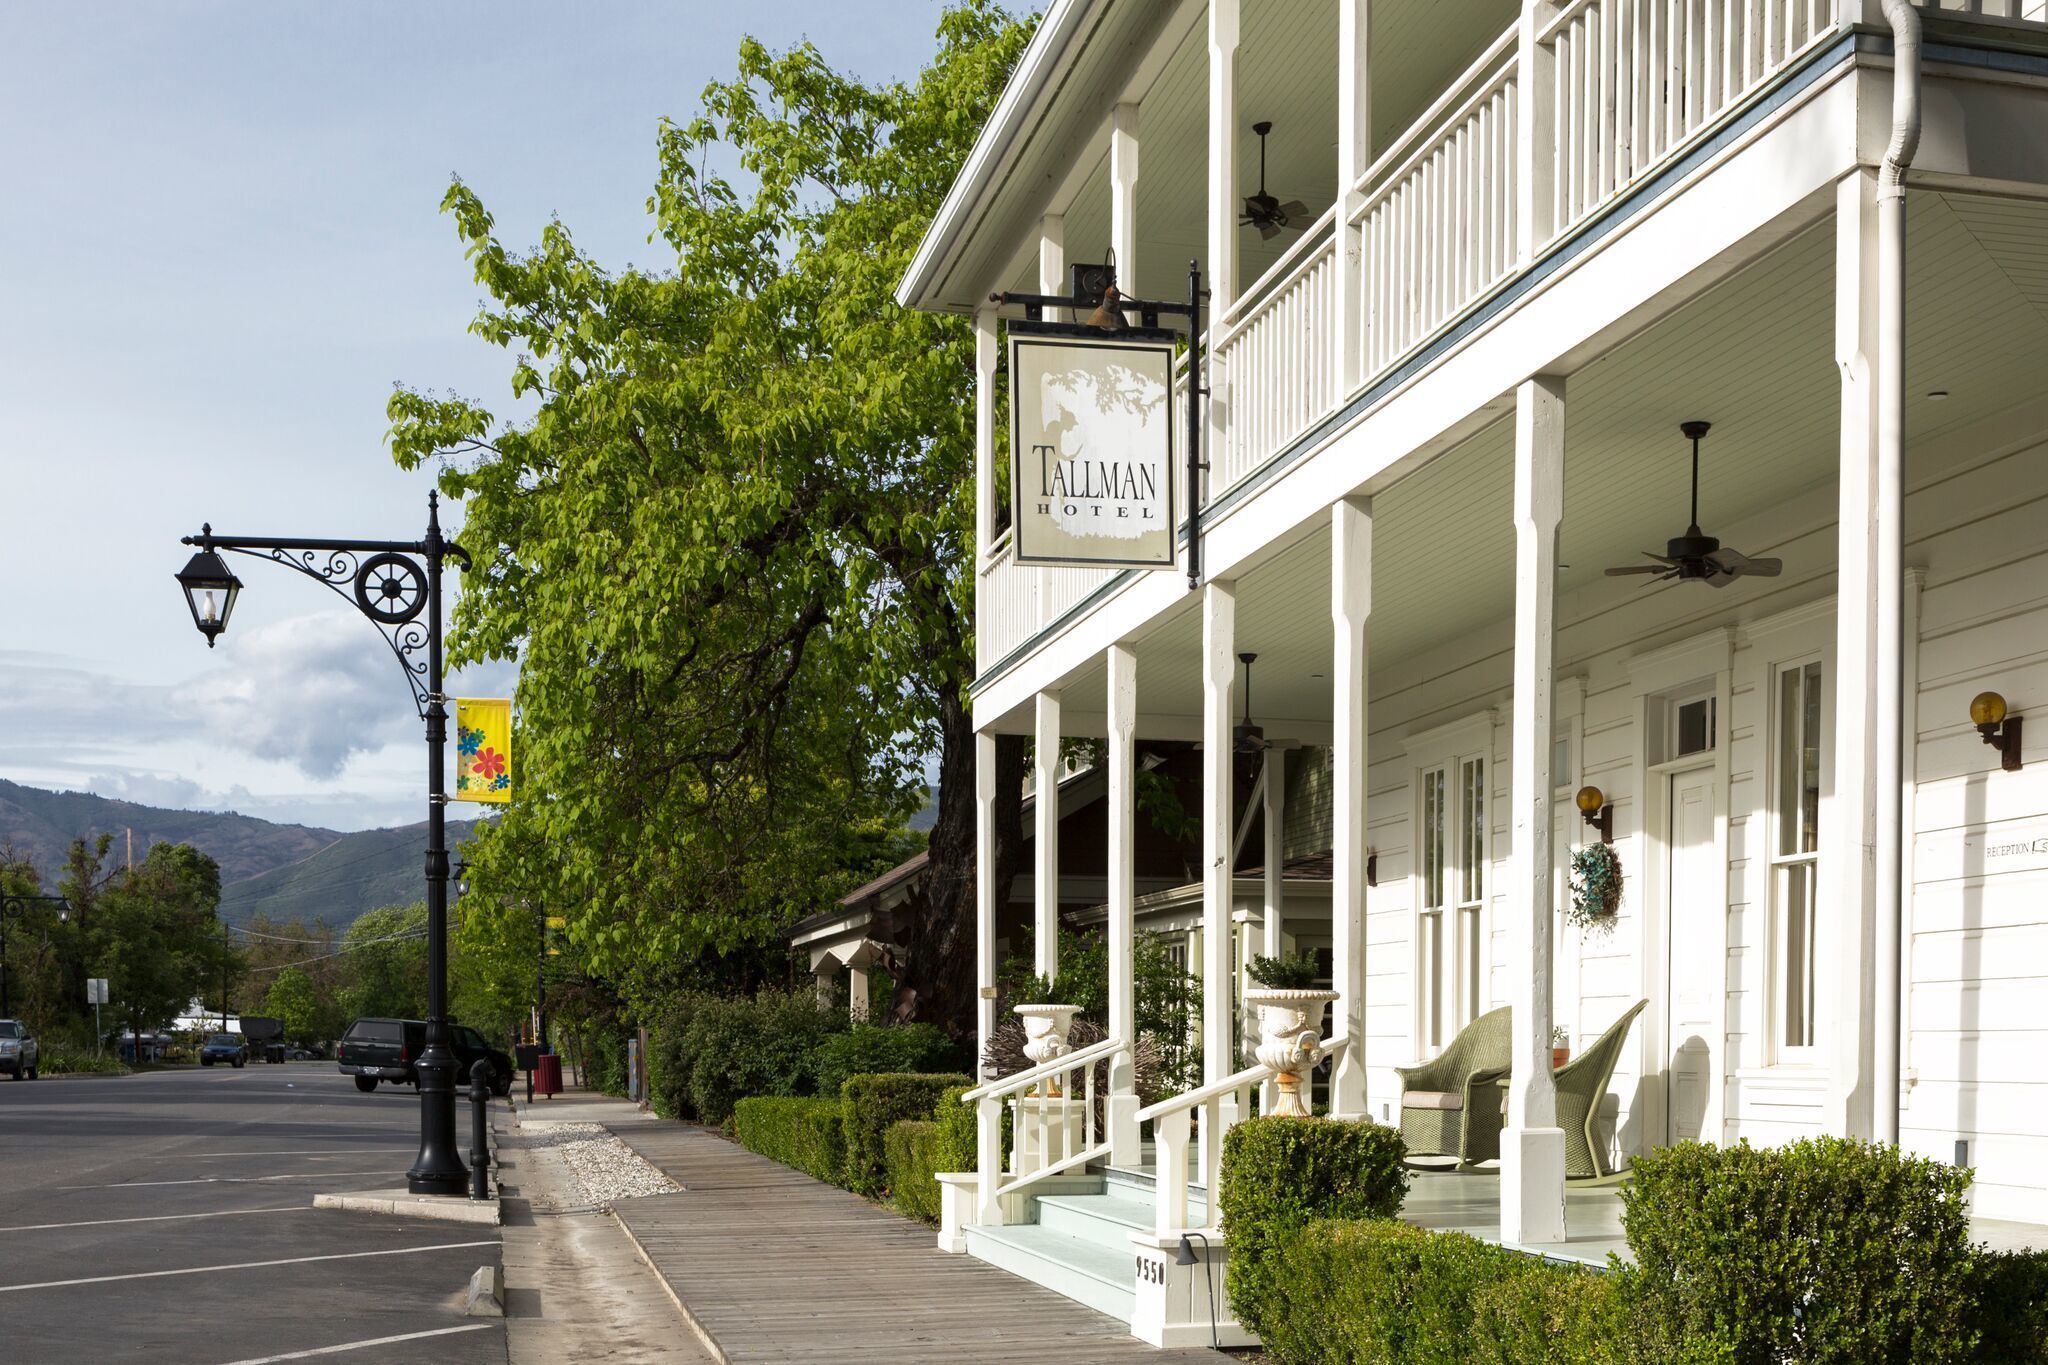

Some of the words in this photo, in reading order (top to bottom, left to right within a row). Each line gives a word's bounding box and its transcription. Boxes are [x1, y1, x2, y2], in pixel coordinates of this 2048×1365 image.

[1032, 445, 1156, 501] TALLMAN
[1037, 503, 1154, 519] HOTEL
[1986, 842, 2030, 858] RECEPTION
[1136, 1255, 1165, 1286] 9550
